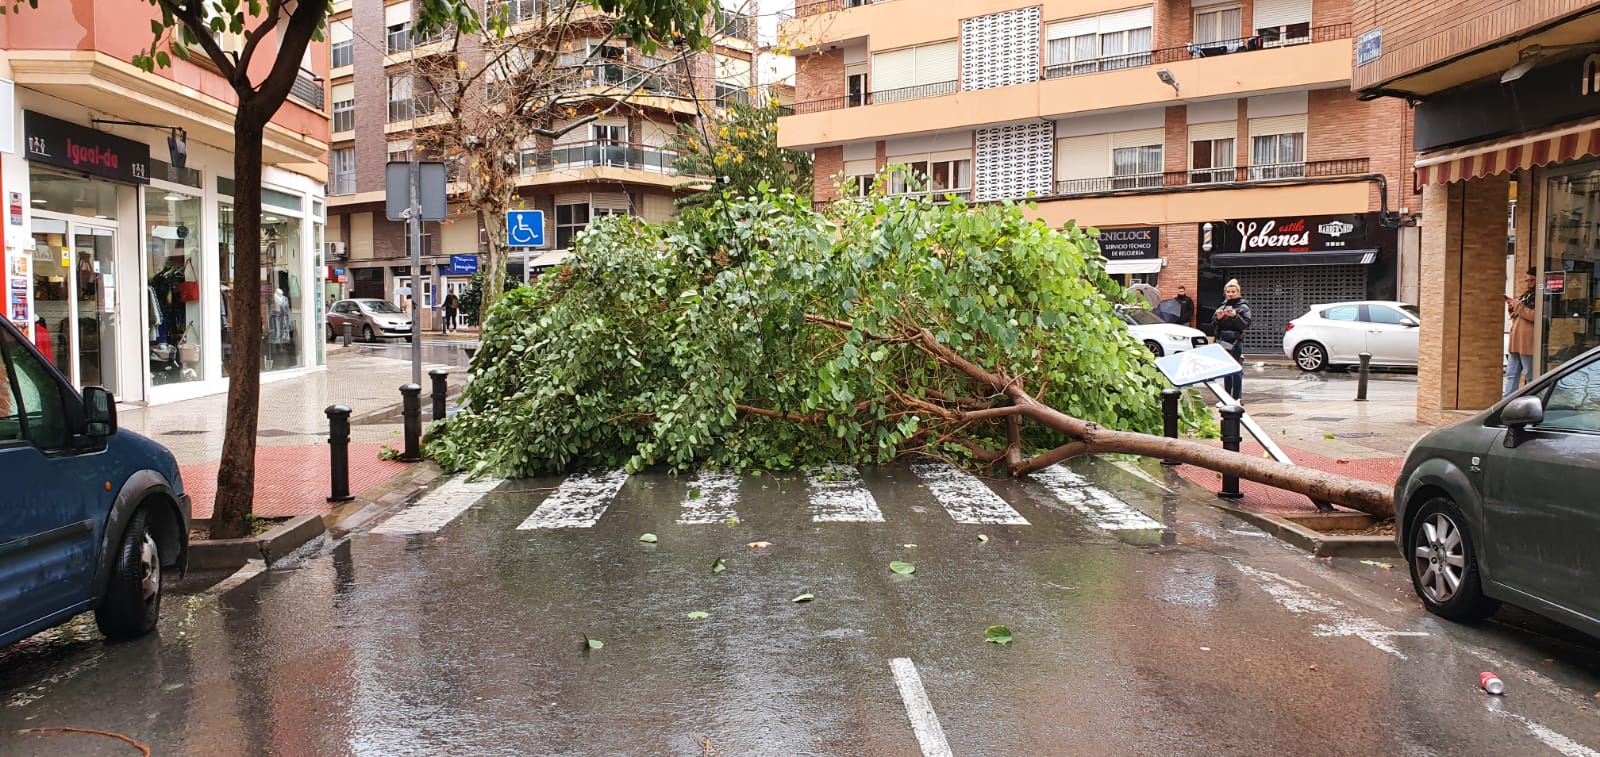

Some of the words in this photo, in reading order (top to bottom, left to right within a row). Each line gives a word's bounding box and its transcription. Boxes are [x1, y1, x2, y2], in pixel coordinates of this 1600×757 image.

[67, 137, 118, 169] Igual-da
[1237, 220, 1310, 252] Yebenes
[1279, 219, 1304, 232] estilo
